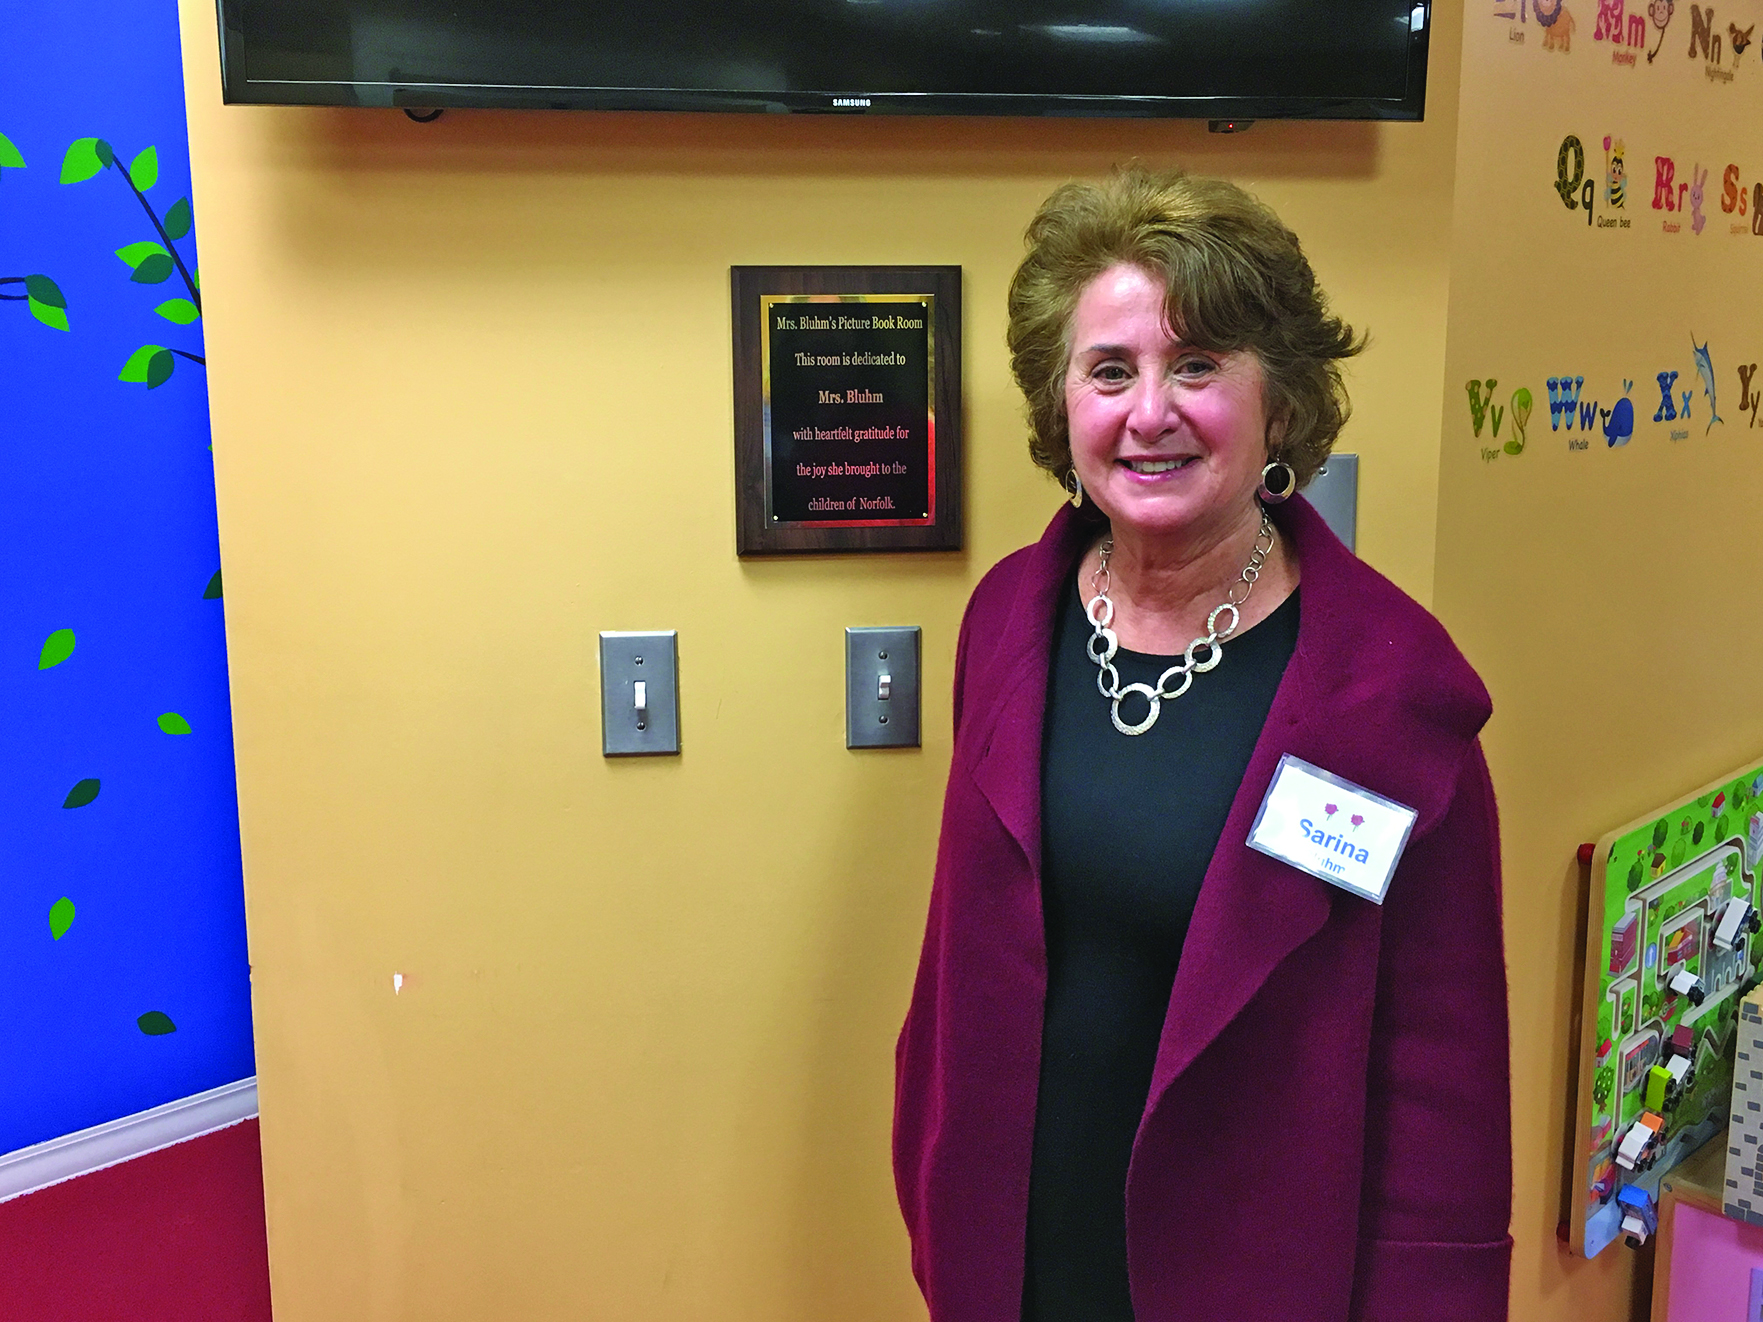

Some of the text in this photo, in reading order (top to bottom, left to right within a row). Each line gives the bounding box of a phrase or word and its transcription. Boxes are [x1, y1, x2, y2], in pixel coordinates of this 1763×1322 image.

[1509, 26, 1525, 42] Lion
[1688, 4, 1721, 65] Nn
[1612, 50, 1637, 68] Monkey
[833, 98, 871, 107] SAMSUNG
[1554, 135, 1595, 226] Qq
[1652, 156, 1688, 213] Rr
[1721, 163, 1748, 216] Ss
[1597, 215, 1631, 228] Queen bee
[1662, 220, 1681, 233] Rabbit
[777, 315, 923, 330] Mrs. Bluhm's Picture Book Room
[795, 352, 906, 366] This room is dedicated to
[818, 389, 883, 404] Mrs. Bluhm
[1546, 376, 1598, 431] Ww
[1653, 371, 1693, 422] Xx
[1737, 363, 1761, 429] Yy
[1465, 378, 1504, 438] Vv
[793, 426, 910, 443] with heartfelt gratitude for
[1568, 438, 1589, 452] Whale
[1480, 447, 1500, 463] Viper
[796, 461, 907, 479] the joy she brought to the
[808, 497, 896, 511] children of Norfolk.
[1299, 818, 1369, 864] Sarina
